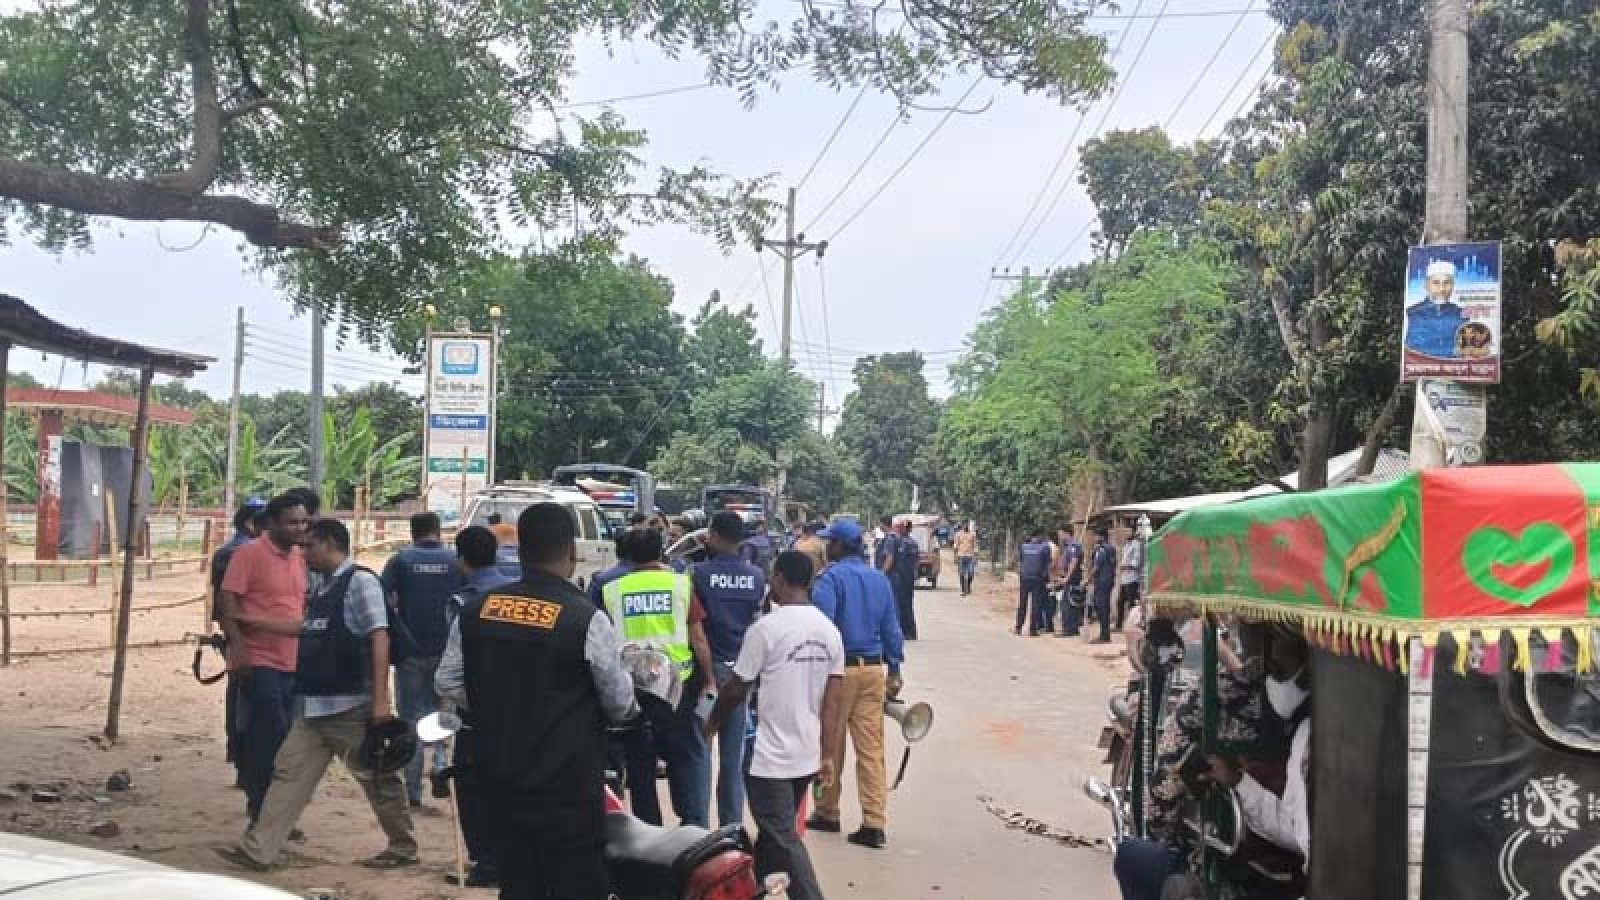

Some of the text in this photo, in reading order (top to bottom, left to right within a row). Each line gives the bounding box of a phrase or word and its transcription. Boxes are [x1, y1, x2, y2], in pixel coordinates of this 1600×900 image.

[709, 573, 755, 590] POLICE
[485, 597, 557, 623] PRESS
[624, 593, 672, 614] POLICE
